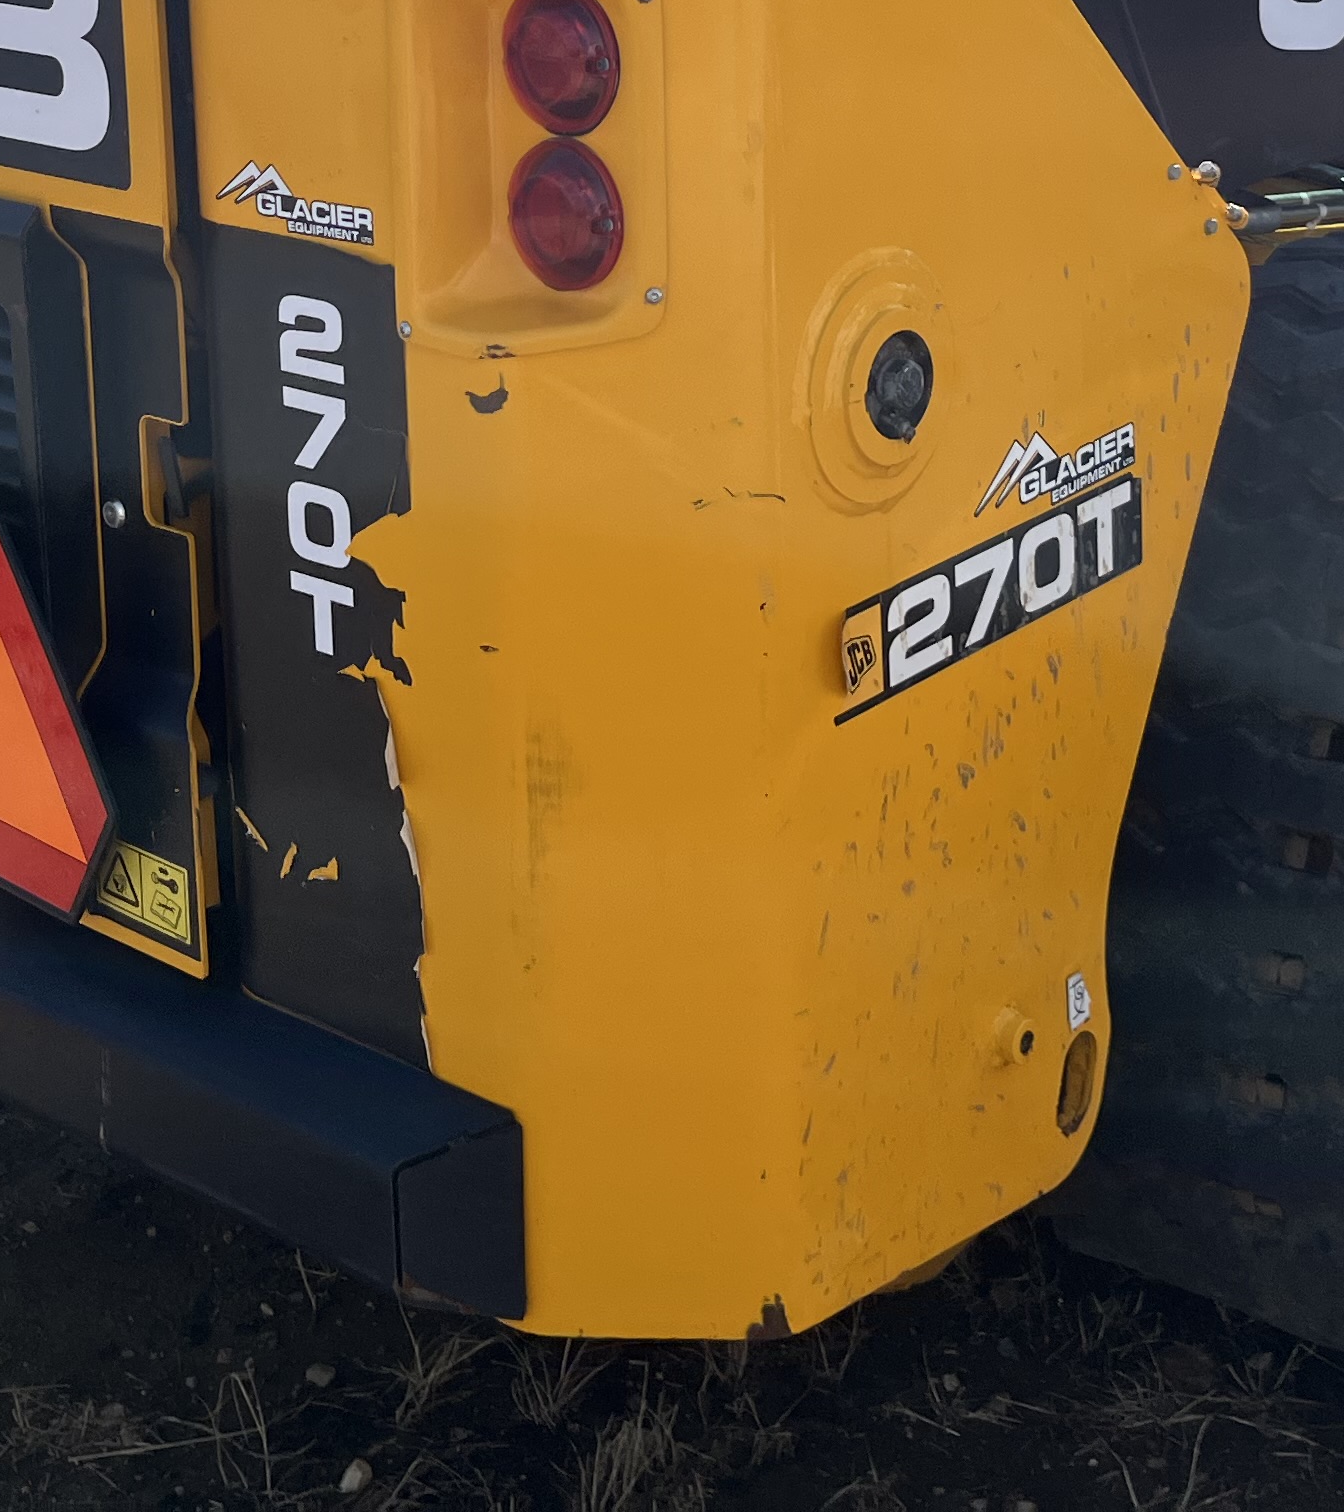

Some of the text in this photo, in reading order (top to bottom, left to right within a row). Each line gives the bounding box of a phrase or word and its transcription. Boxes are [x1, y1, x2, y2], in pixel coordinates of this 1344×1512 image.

[256, 192, 373, 231] GLACIER
[287, 220, 360, 242] EQUIPMENT
[278, 294, 355, 656] 270T
[1019, 422, 1134, 503] GLACIER
[1051, 456, 1122, 503] EQUIPMENT
[887, 479, 1132, 688] 270T
[847, 639, 873, 686] JCB
